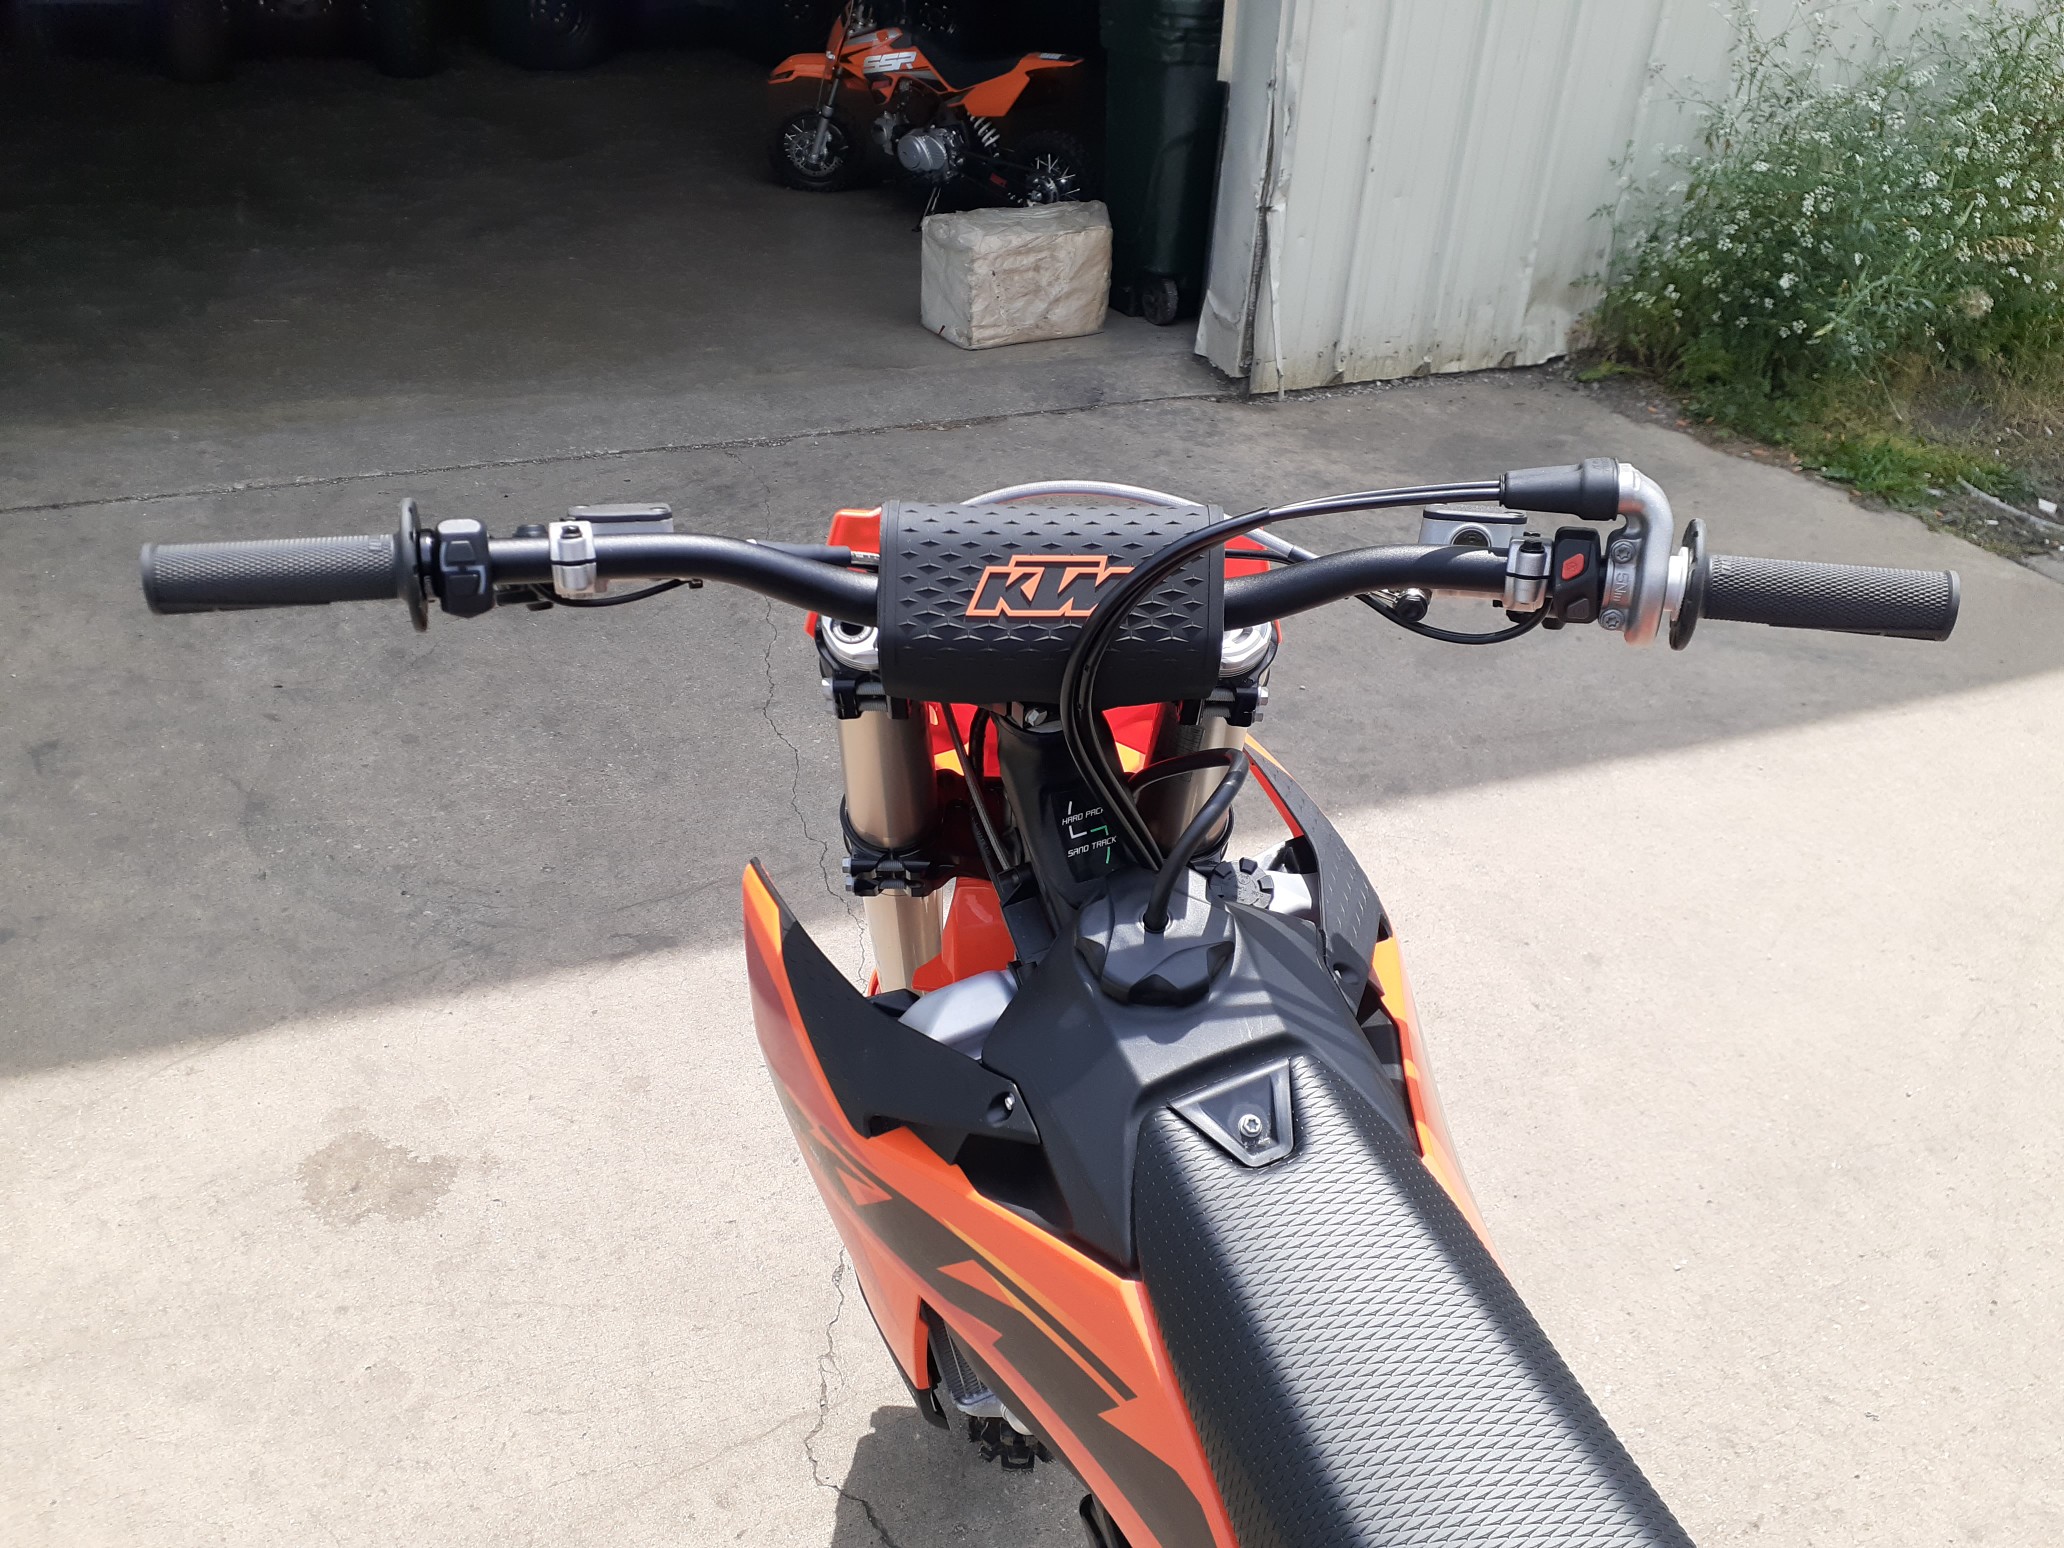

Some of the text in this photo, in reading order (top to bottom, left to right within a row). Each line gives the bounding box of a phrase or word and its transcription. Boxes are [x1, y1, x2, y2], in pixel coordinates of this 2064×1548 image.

[863, 51, 917, 72] SSR
[1061, 812, 1084, 826] HARD
[1067, 835, 1117, 858] SAND TRACK
